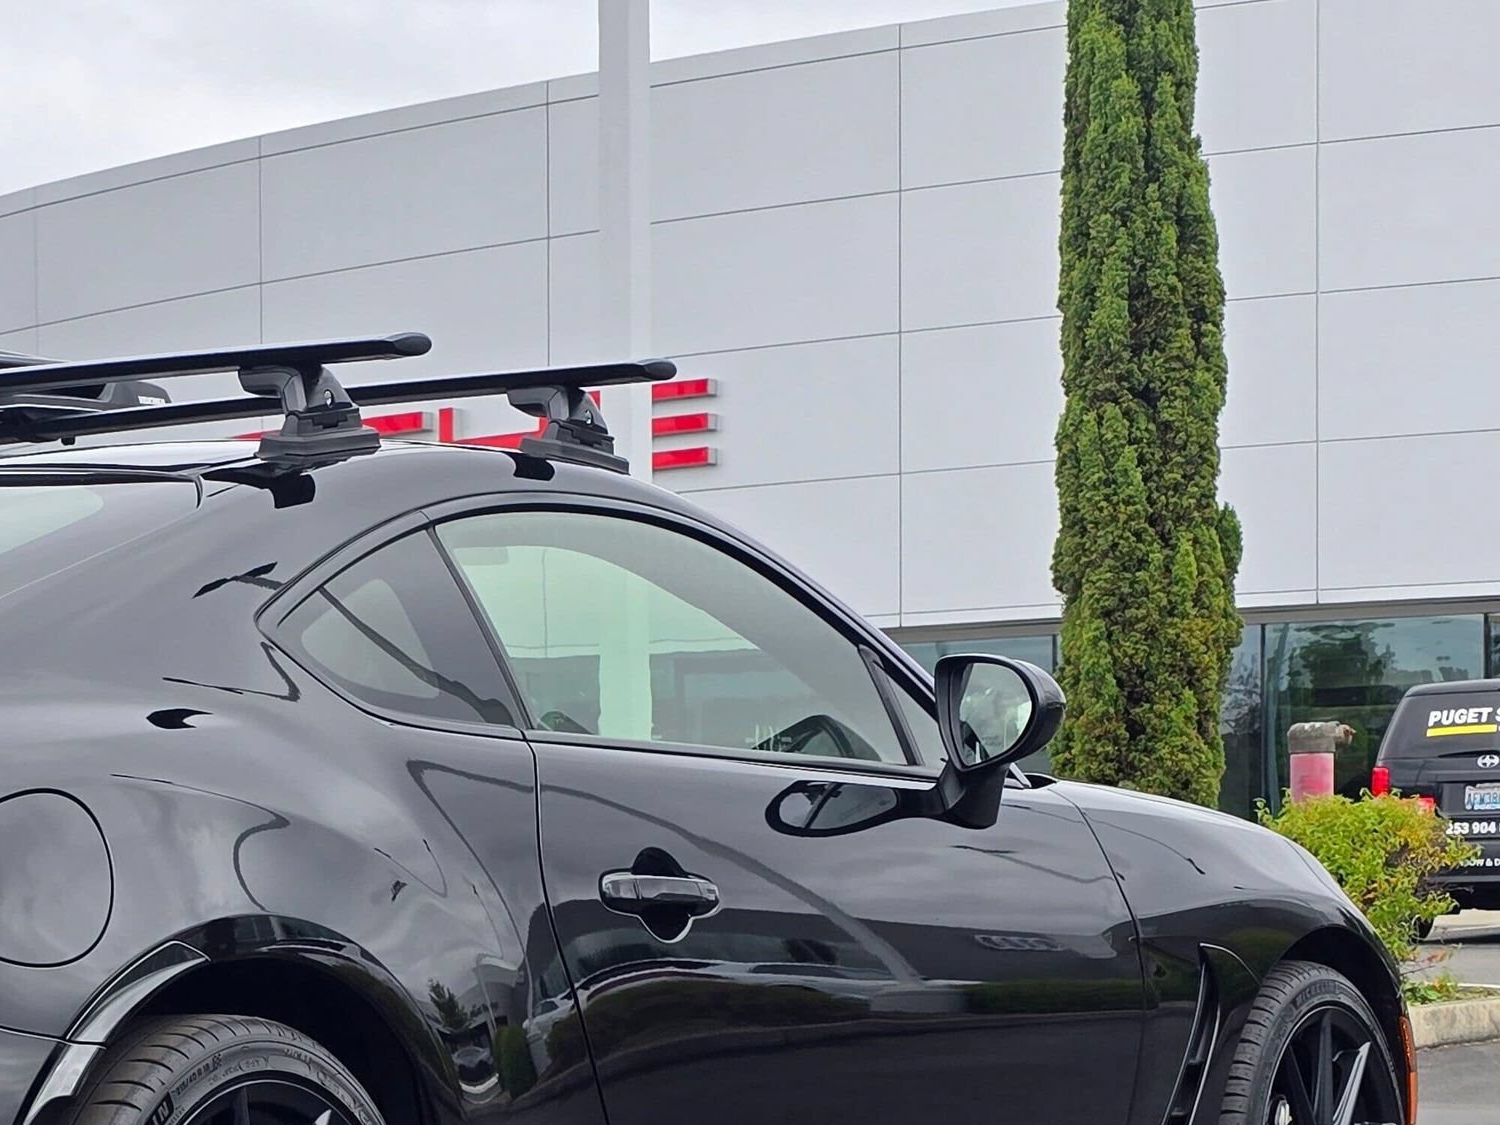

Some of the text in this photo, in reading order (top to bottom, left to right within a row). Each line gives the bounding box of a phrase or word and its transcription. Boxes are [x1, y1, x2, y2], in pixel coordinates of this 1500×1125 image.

[1428, 707, 1493, 727] PUGET
[1446, 821, 1496, 834] 253 904
